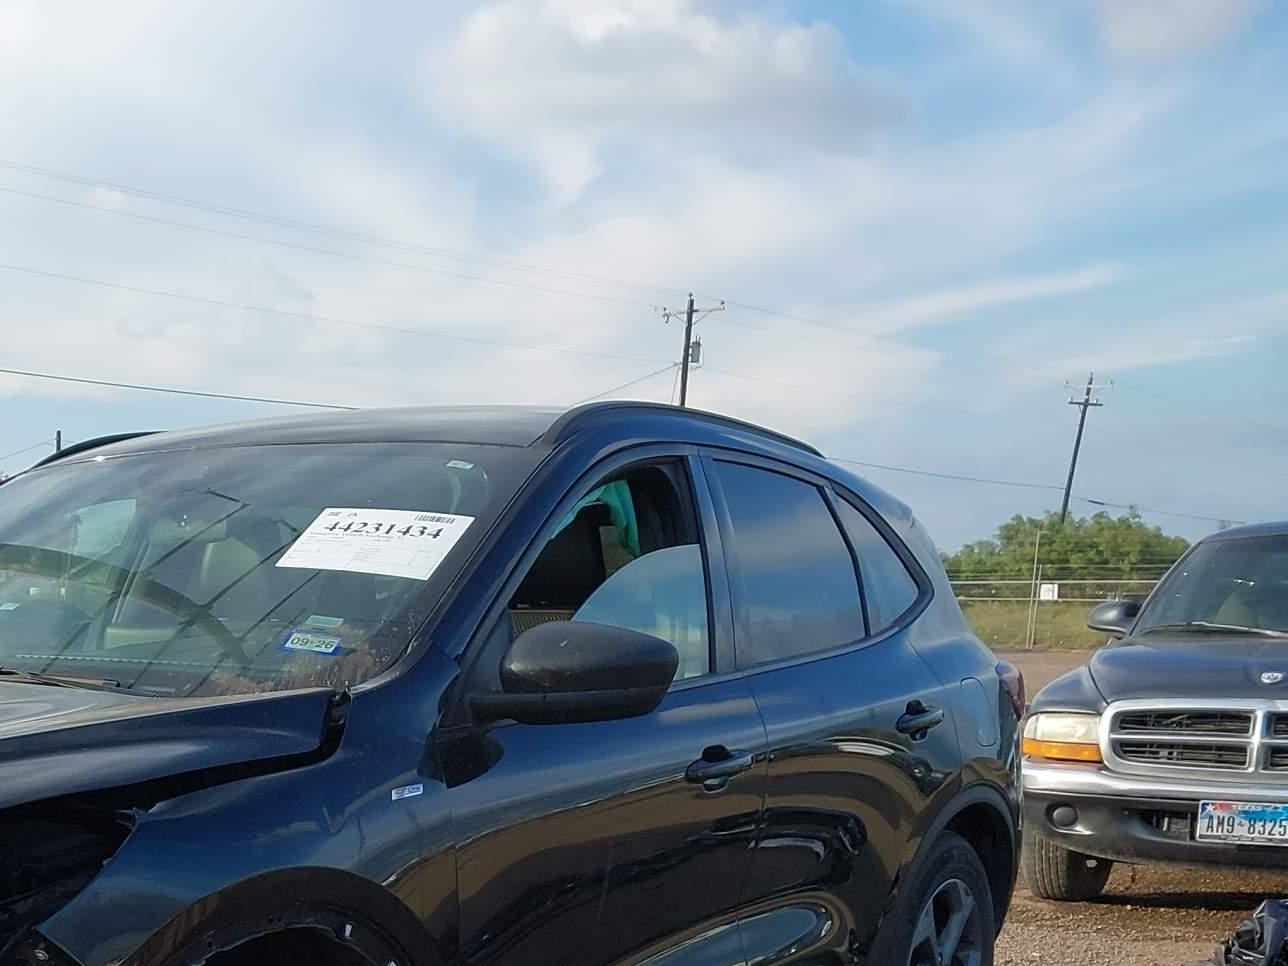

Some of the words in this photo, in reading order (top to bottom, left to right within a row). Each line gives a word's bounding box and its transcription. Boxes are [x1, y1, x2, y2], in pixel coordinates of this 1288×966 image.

[324, 521, 444, 539] 44231434
[291, 637, 310, 646] 09
[314, 640, 335, 649] 26
